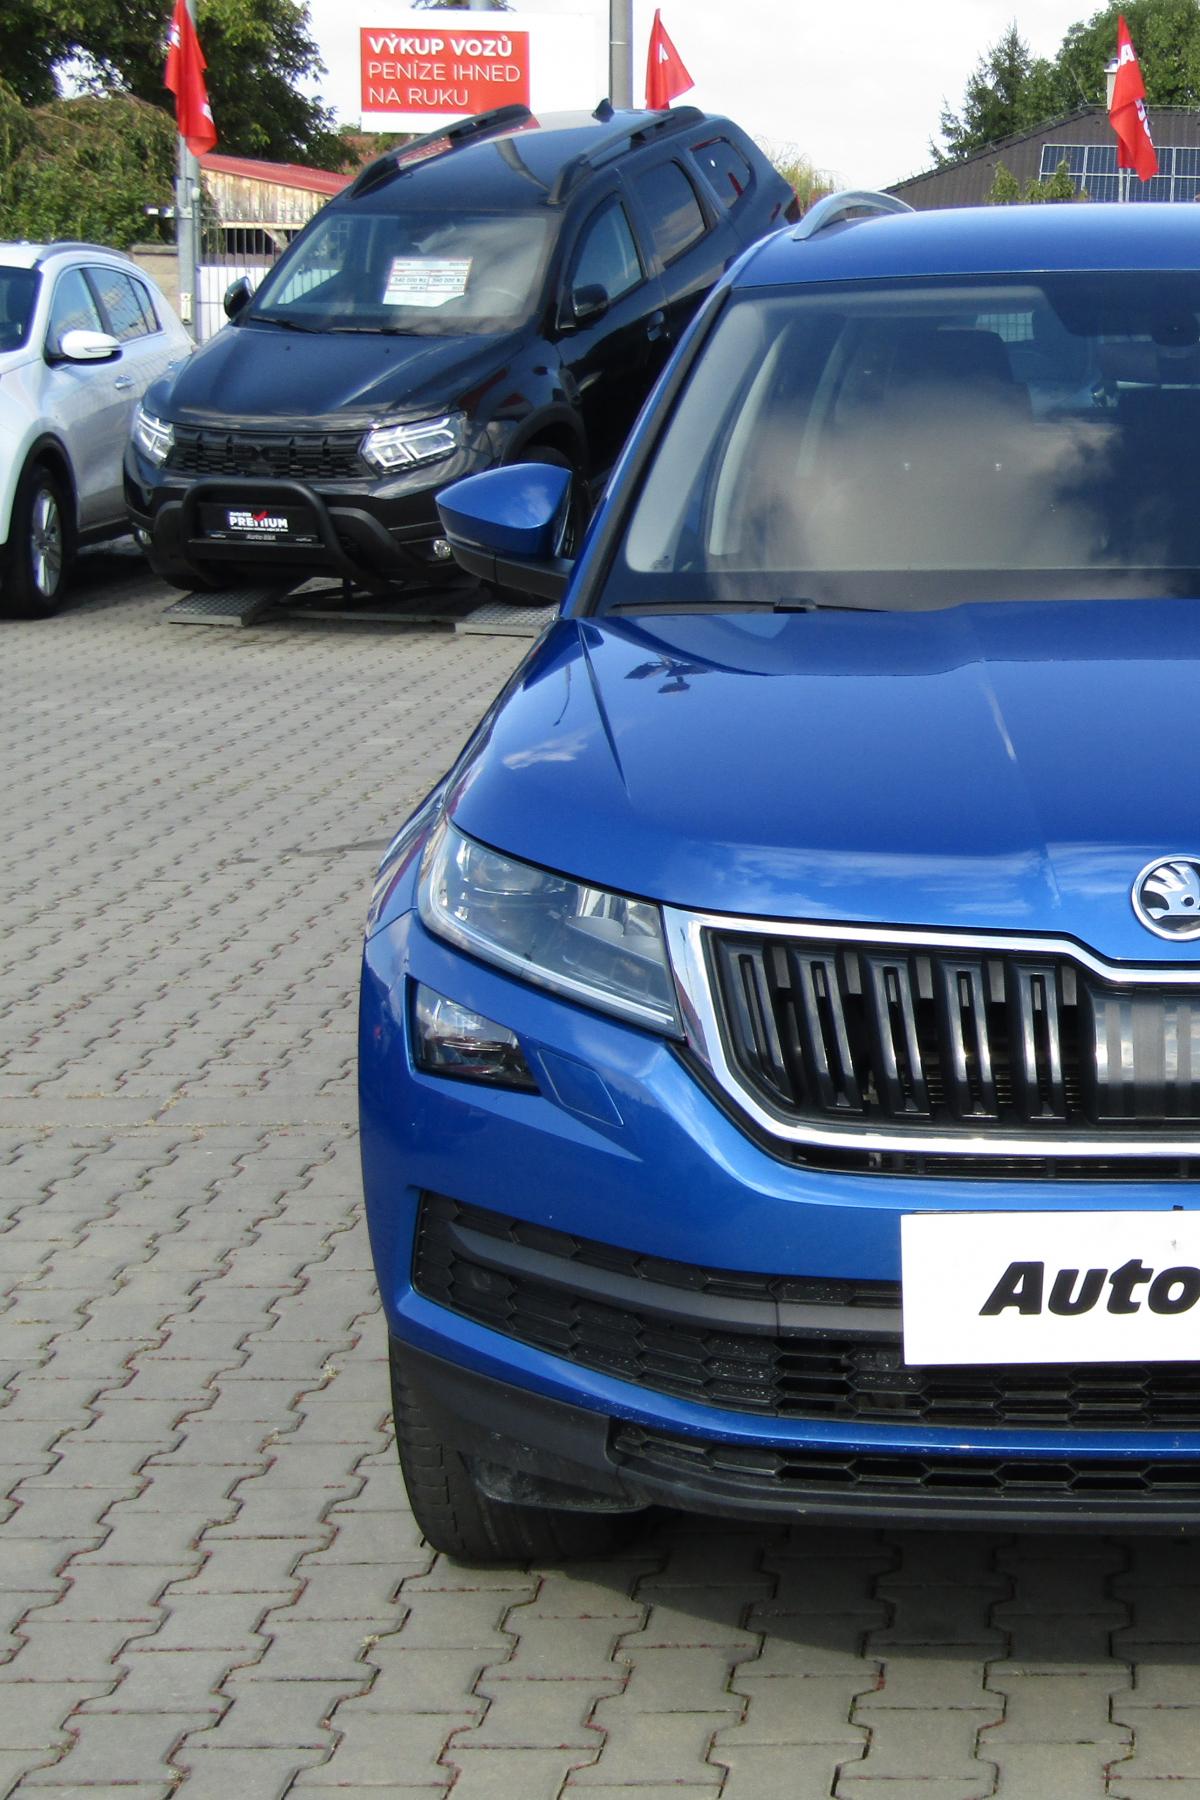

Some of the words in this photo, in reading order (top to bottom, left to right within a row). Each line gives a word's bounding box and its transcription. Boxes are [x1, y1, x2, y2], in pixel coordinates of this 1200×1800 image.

[369, 33, 445, 56] VÝKUP
[450, 35, 512, 57] VOZŮ
[368, 60, 446, 81] PENÍZE
[453, 64, 521, 82] IHNED
[369, 87, 401, 105] NA
[408, 88, 469, 106] RUKU
